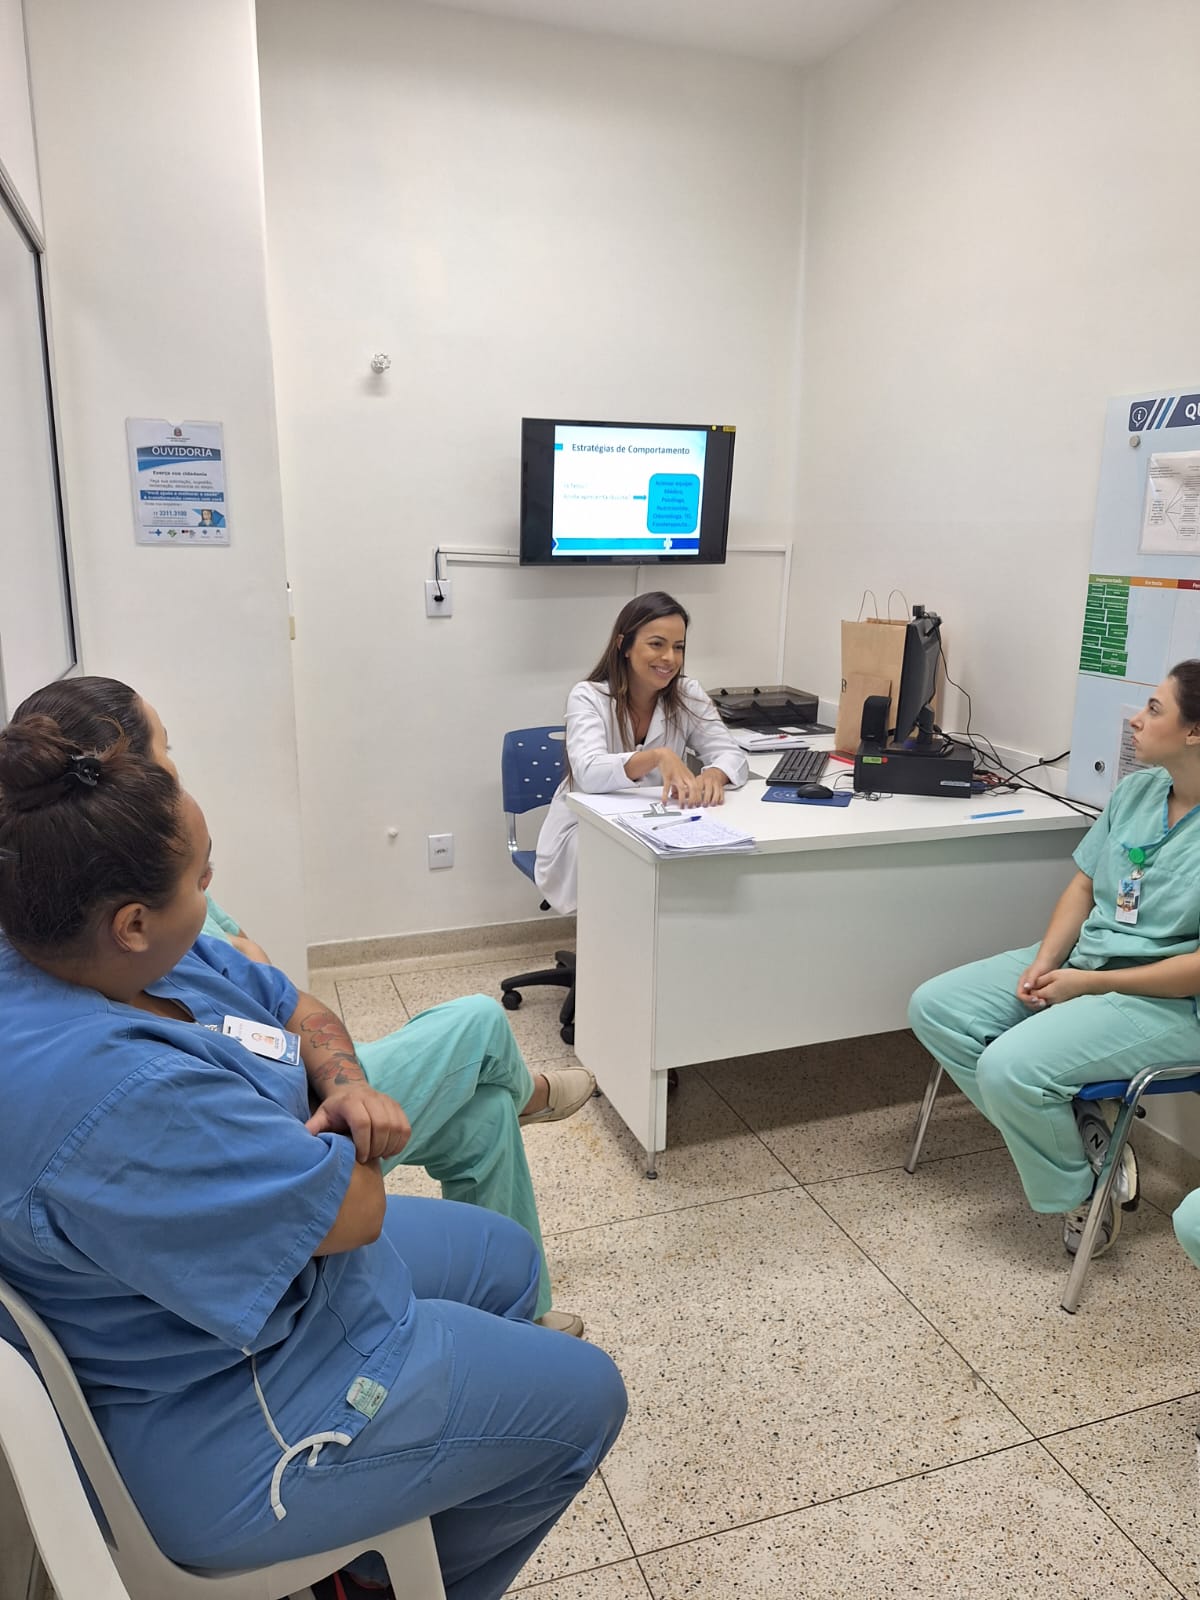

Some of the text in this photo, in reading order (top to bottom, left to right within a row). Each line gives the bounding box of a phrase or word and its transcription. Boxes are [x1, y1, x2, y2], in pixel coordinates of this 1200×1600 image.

[1185, 402, 1200, 421] Q
[151, 446, 213, 457] OUVIDORIA
[572, 443, 690, 455] Estratégias de Comportamento
[1090, 1133, 1104, 1150] N
